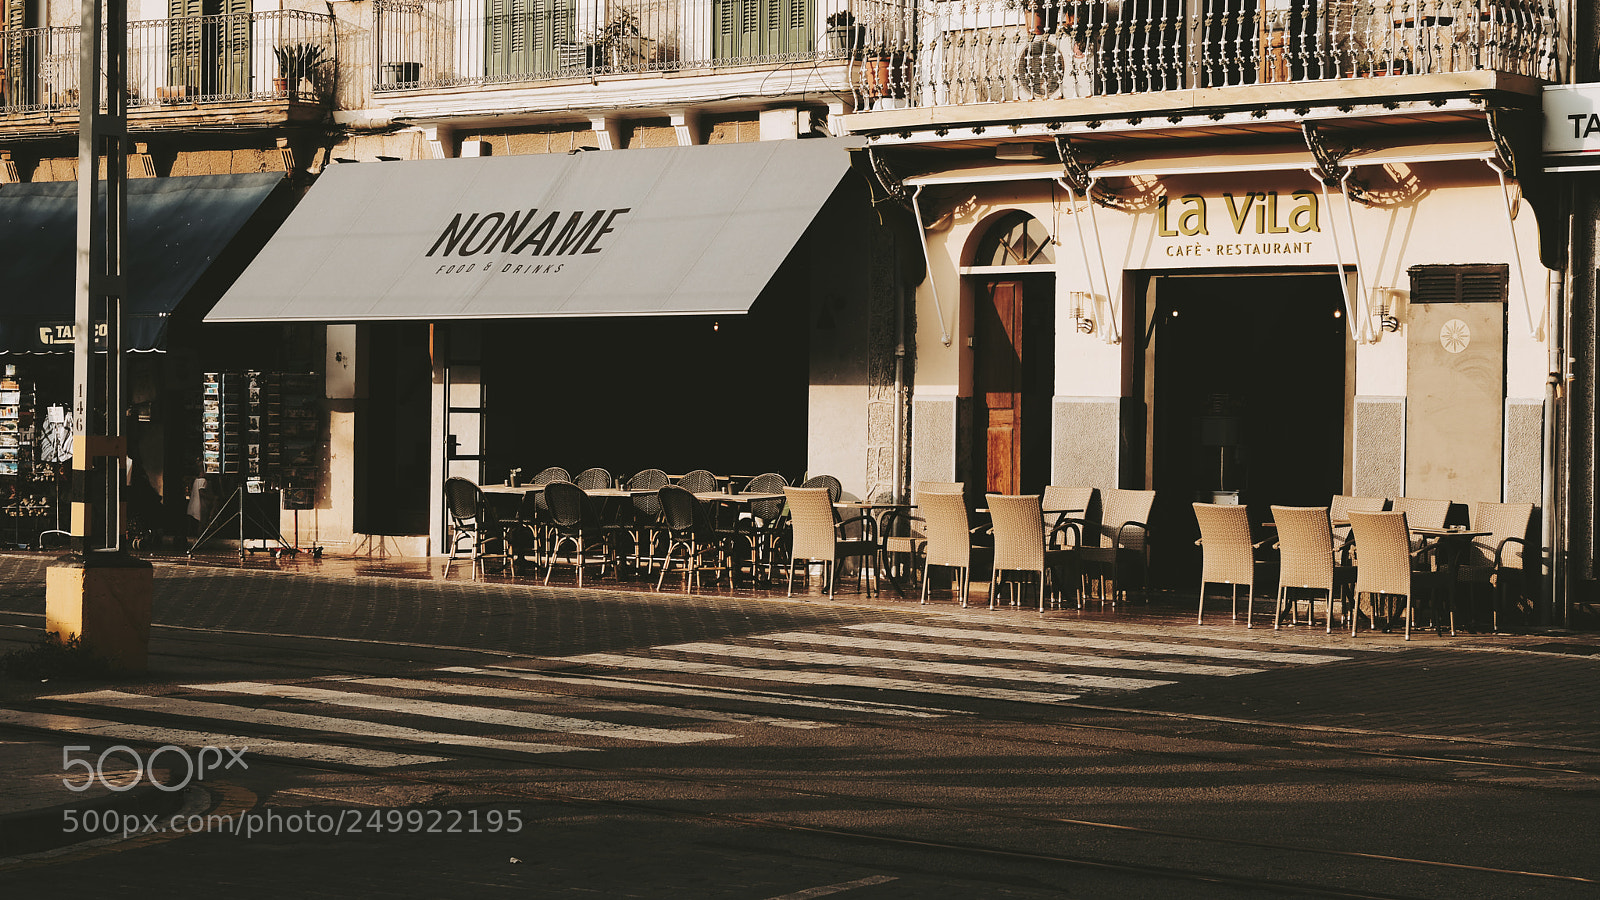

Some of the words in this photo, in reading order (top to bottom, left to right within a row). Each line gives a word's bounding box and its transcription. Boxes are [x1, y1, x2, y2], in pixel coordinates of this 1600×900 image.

[425, 207, 632, 257] NONAME
[1166, 242, 1202, 257] CAFÈ
[1216, 242, 1313, 256] RESTAURANT
[435, 264, 476, 275] FOOD
[483, 261, 493, 272] &
[501, 263, 565, 274] DRINKS
